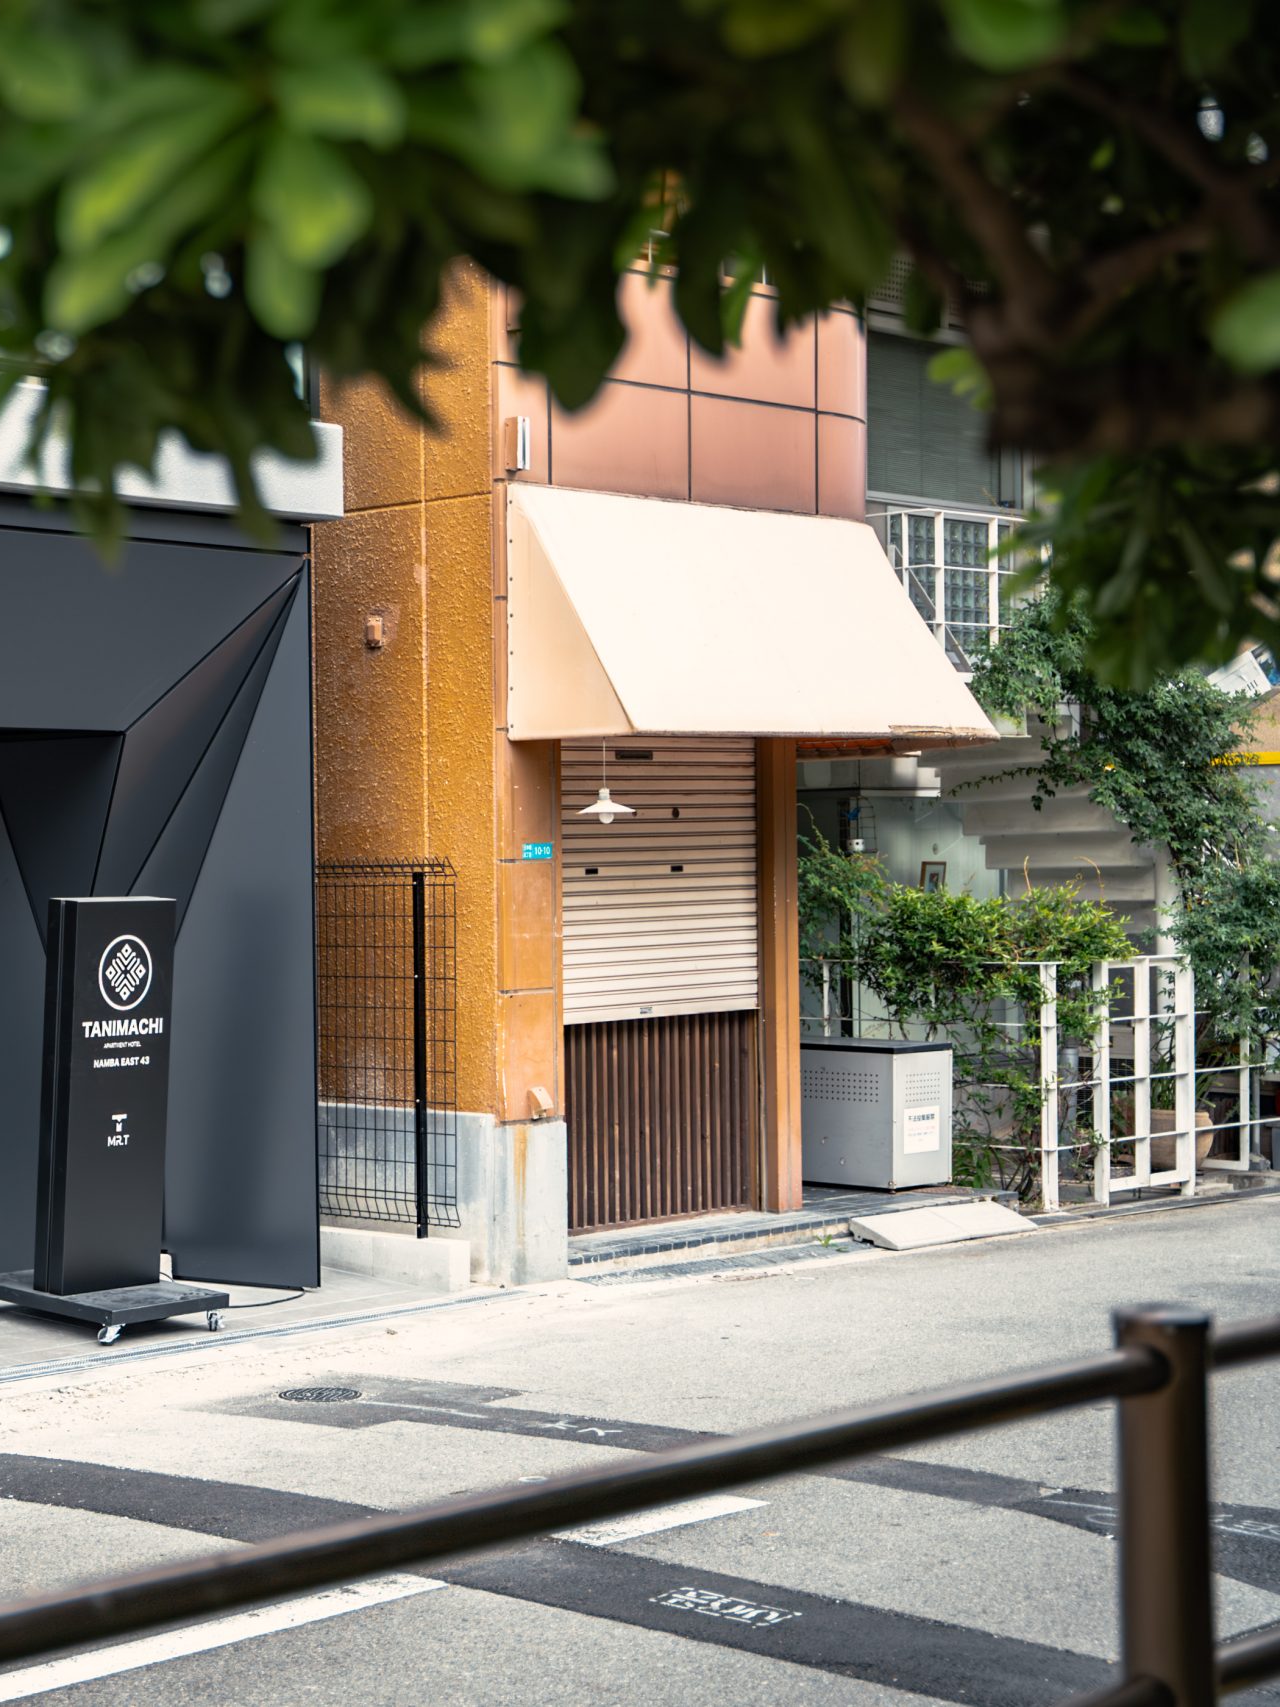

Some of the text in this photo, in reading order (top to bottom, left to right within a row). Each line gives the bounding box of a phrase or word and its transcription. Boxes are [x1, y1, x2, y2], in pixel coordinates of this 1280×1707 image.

[82, 1017, 164, 1038] TANIMACHI
[93, 1056, 150, 1069] NAMBA EAST 43
[107, 1134, 130, 1147] MR.T
